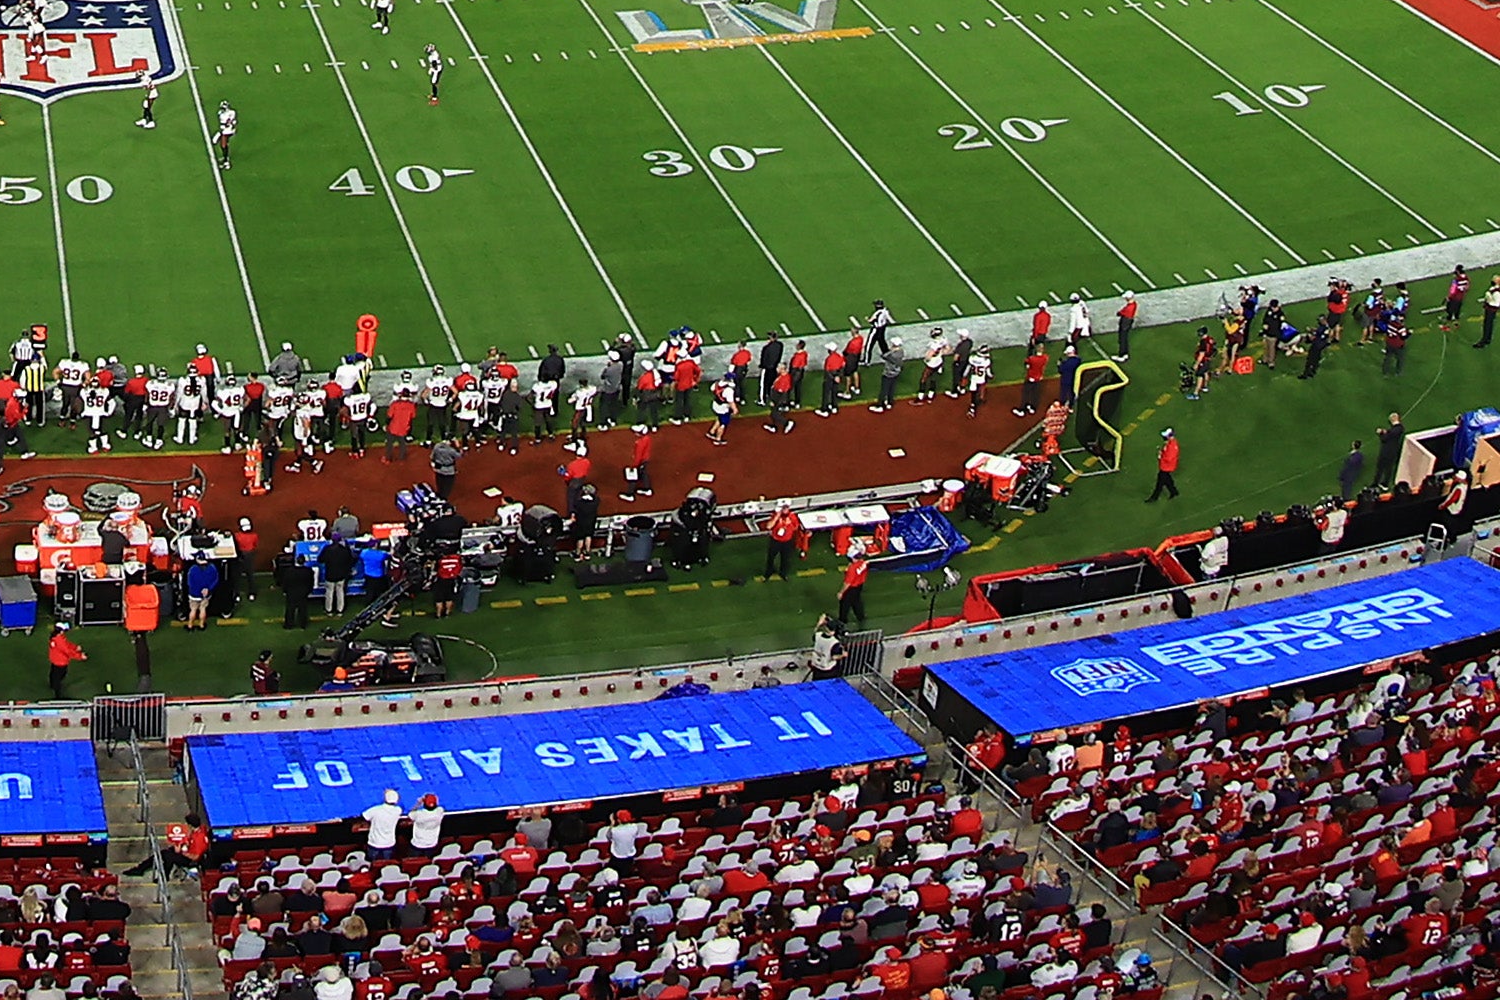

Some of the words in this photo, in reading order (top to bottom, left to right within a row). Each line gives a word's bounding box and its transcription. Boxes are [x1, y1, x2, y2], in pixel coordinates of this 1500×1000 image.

[1212, 83, 1311, 118] 10
[936, 116, 1048, 151] 20
[642, 144, 758, 178] 30
[328, 167, 443, 197] 40
[32, 325, 48, 342] 3
[63, 367, 81, 381] 93
[150, 389, 169, 402] 92
[306, 526, 322, 540] 81
[1142, 587, 1444, 664] CHANGE
[1180, 606, 1455, 677] INSPIRE
[1059, 660, 1127, 684] NFL
[769, 710, 835, 741] IT
[539, 720, 753, 769] TAKES
[271, 760, 357, 791] OF
[378, 746, 503, 782] ALL
[1056, 756, 1073, 772] 12
[893, 779, 911, 793] 30
[1001, 923, 1023, 941] 12
[1422, 928, 1443, 945] 12
